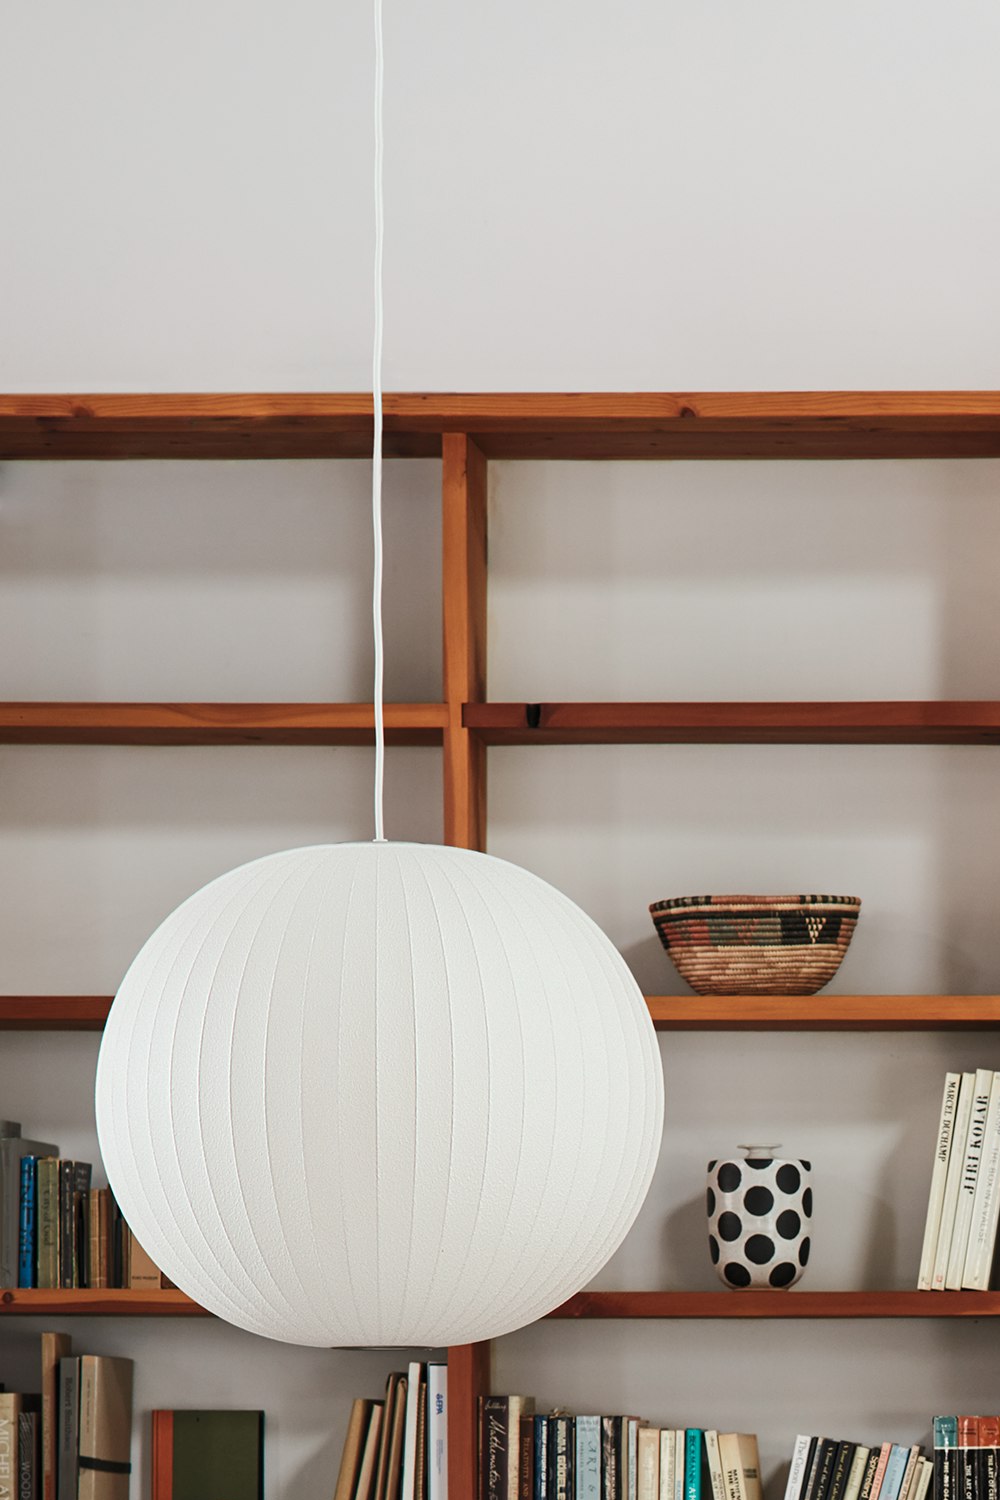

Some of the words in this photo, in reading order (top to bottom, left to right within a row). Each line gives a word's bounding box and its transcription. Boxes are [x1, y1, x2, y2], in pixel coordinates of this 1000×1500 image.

[945, 1081, 957, 1116] MARCEL
[938, 1119, 952, 1162] DUCHAMP
[989, 1148, 999, 1165] THE
[64, 1377, 73, 1407] Robert
[586, 1441, 599, 1473] ART
[688, 1486, 697, 1494] A
[859, 1455, 880, 1499] Sphereland
[988, 1479, 994, 1488] OF
